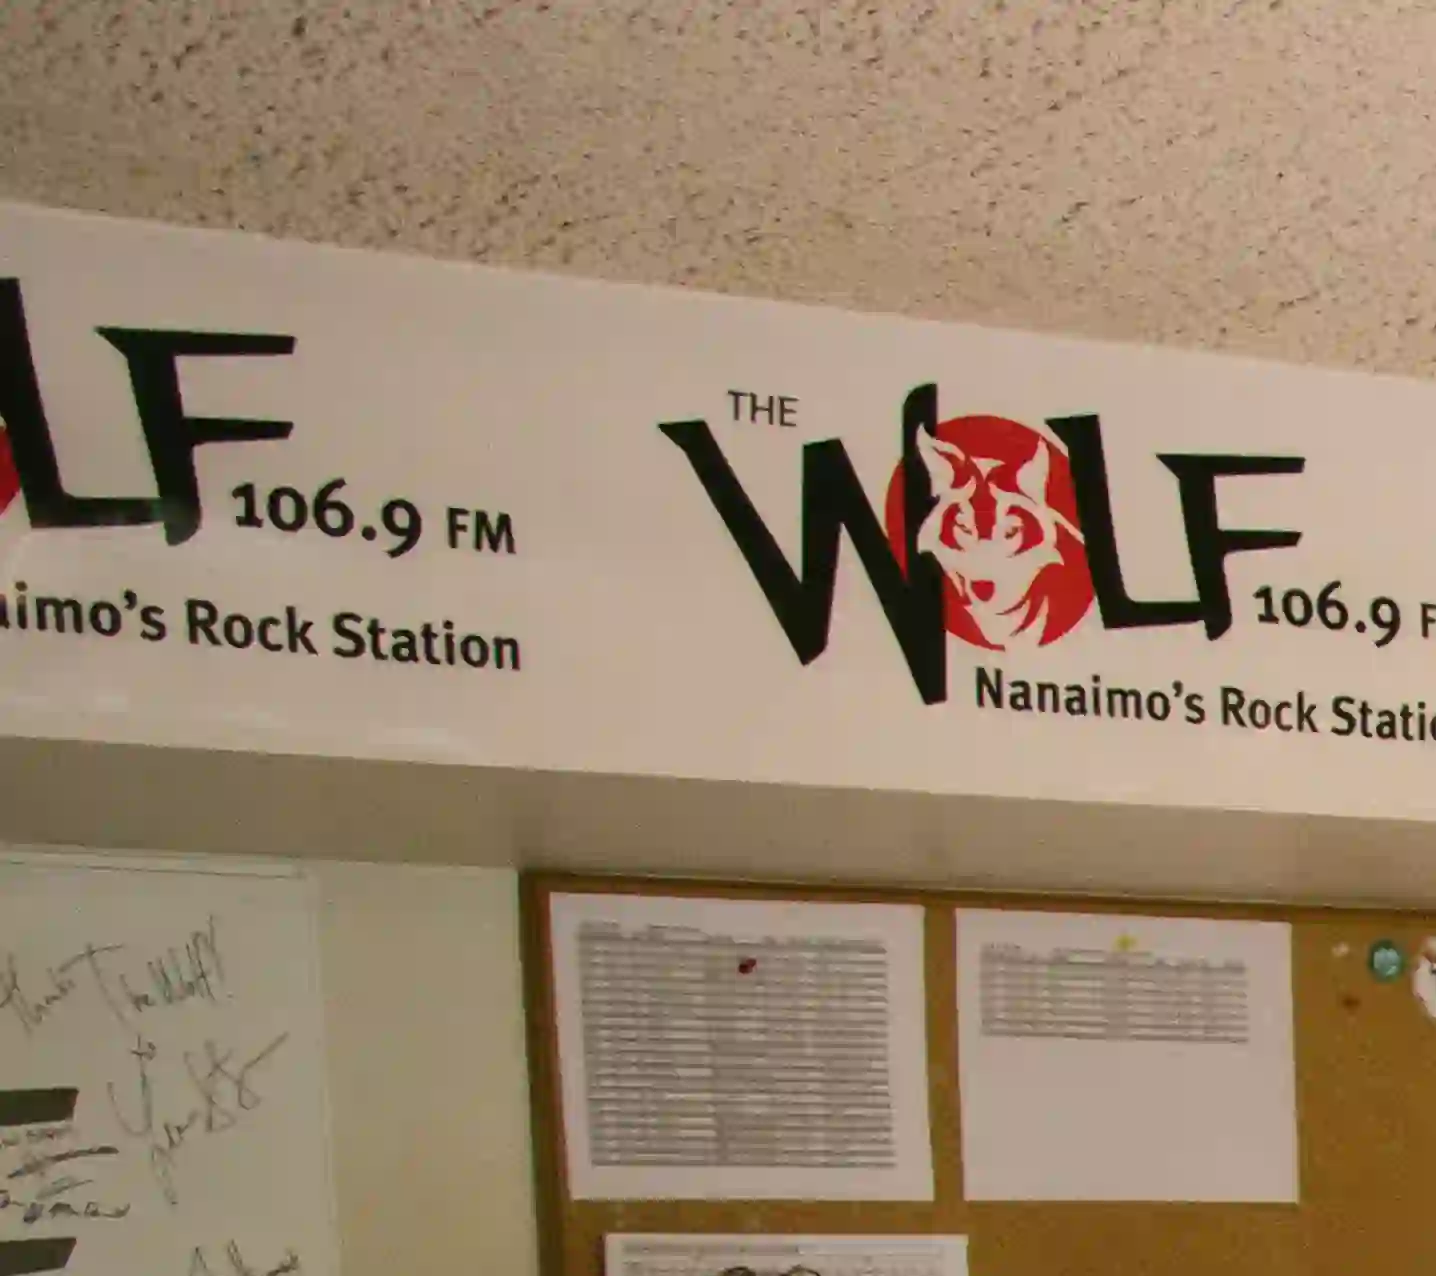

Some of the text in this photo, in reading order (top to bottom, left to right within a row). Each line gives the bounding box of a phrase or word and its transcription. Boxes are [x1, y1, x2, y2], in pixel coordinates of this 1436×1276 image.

[0, 276, 296, 547] LF
[727, 390, 798, 427] THE
[232, 478, 516, 554] 106.9 FM
[659, 382, 1306, 705] WOLF
[0, 583, 521, 670] imo's Rock Station
[1255, 583, 1402, 646] 106.9
[976, 667, 1206, 726] Nanaimo's
[1221, 688, 1317, 734] Rock
